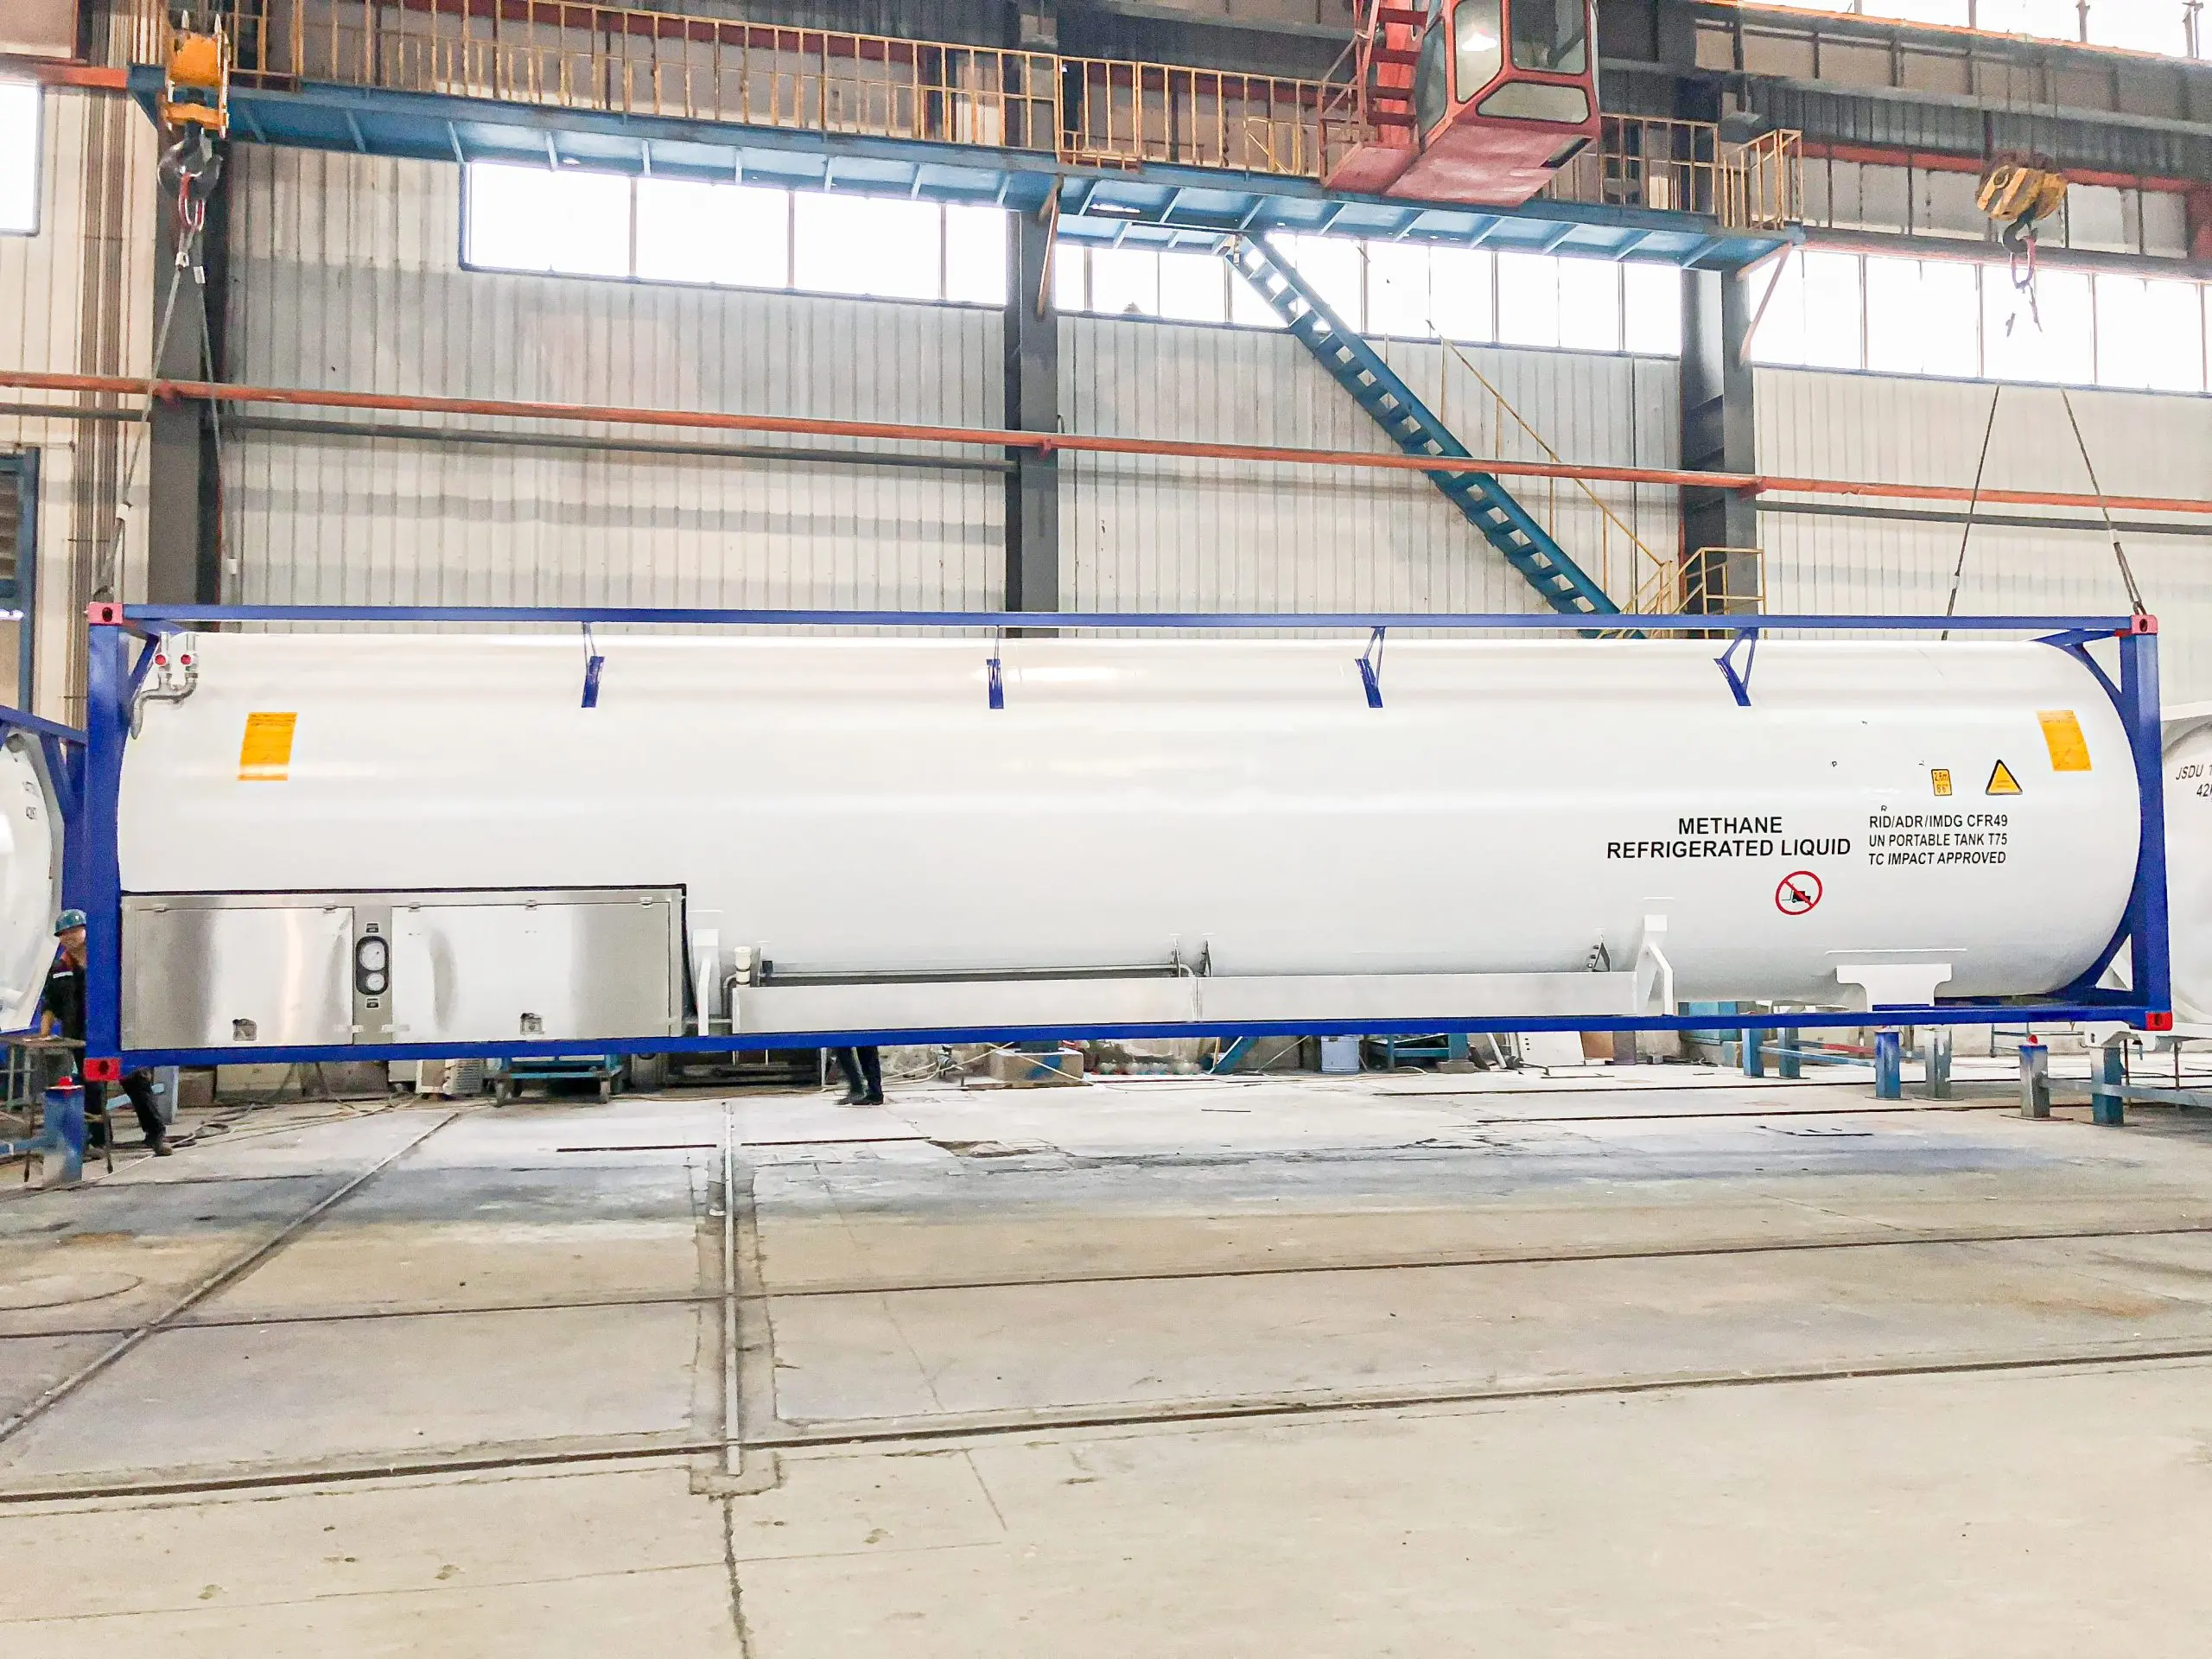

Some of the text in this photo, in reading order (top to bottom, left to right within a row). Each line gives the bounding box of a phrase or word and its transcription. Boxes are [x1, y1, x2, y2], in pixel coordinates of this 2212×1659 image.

[2176, 765, 2203, 780] JSDU
[1678, 816, 1783, 836] METHANE
[1869, 814, 2008, 829] RID/ADR/IMDG CFR49
[1869, 832, 2007, 848] UN PORTABLE TANK T75
[1607, 838, 1851, 859] REFRIGERATED LIQUID
[1868, 851, 2006, 866] TC IMPACT APPROVED
